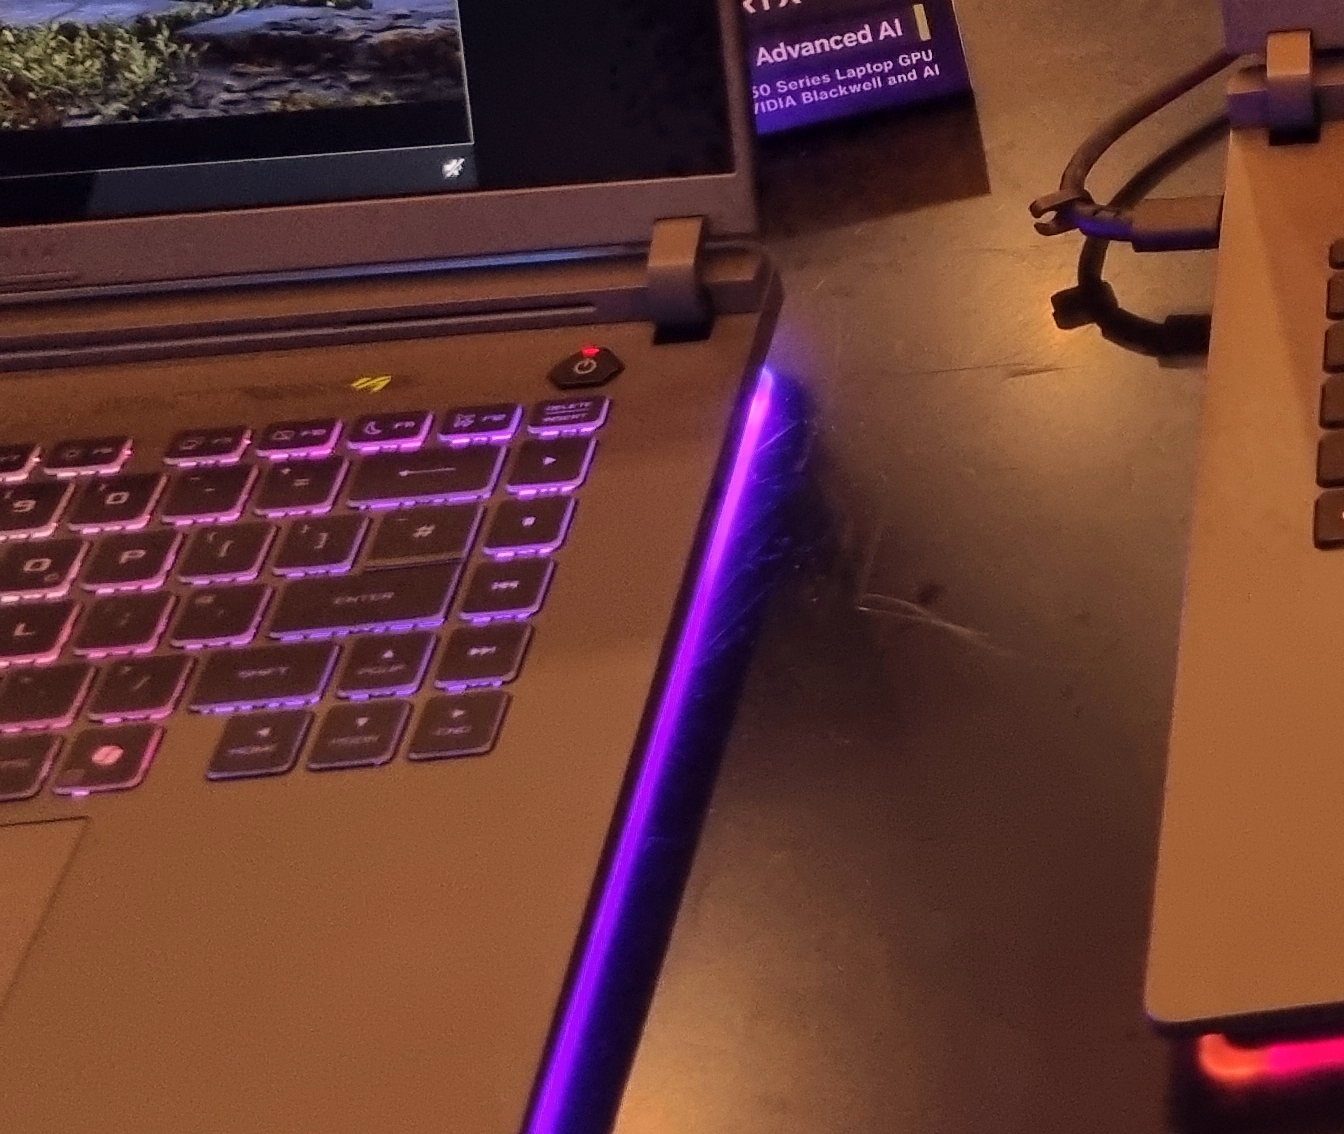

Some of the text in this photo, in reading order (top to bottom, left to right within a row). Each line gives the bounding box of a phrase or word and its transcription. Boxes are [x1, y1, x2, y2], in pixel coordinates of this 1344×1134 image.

[757, 19, 902, 67] Advanced AI
[776, 75, 831, 95] Series
[836, 61, 894, 81] Laptop
[899, 50, 932, 68] GPU
[802, 76, 882, 104] Blackwell
[887, 69, 917, 85] and
[924, 64, 939, 77] AI
